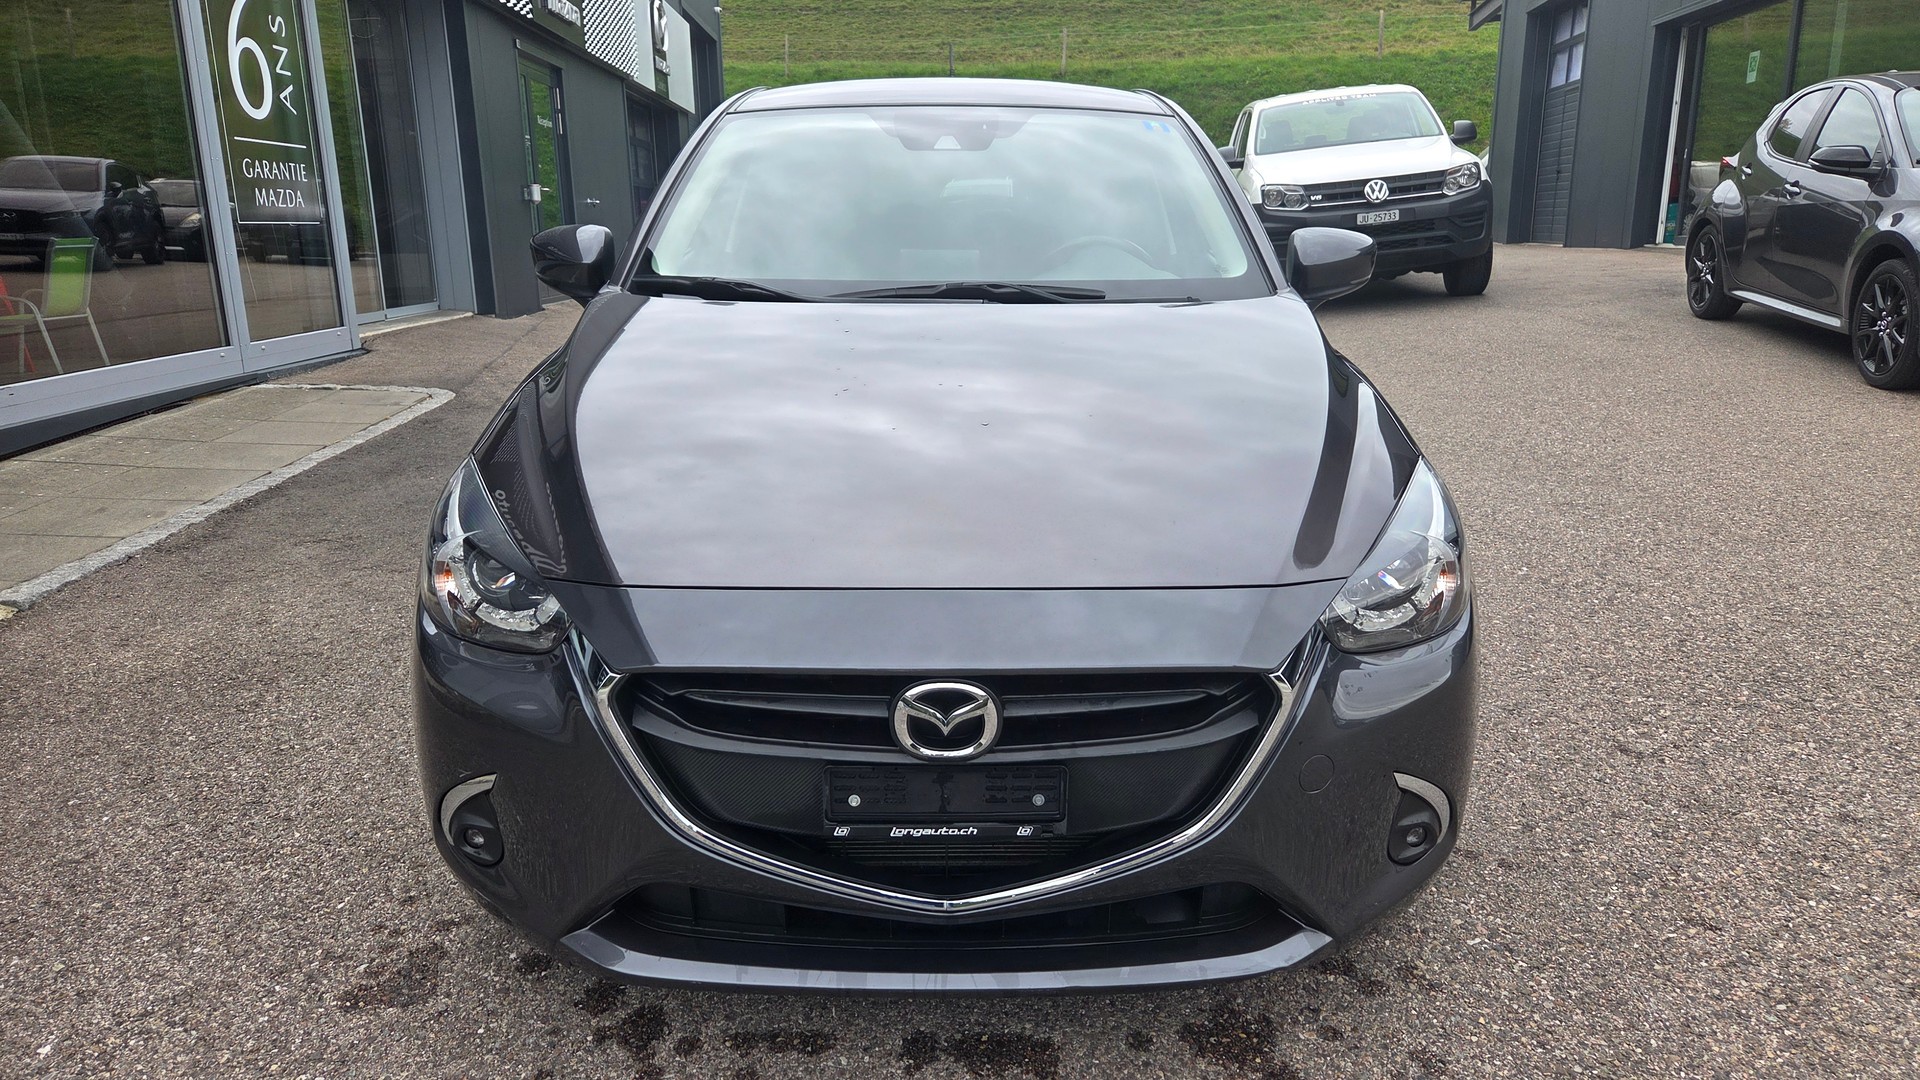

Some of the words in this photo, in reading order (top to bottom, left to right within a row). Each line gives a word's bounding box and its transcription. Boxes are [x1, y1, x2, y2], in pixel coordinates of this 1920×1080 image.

[227, 0, 273, 120] 6
[268, 14, 298, 115] ANS
[242, 158, 308, 182] GARANTIE
[254, 188, 305, 208] MAZDA
